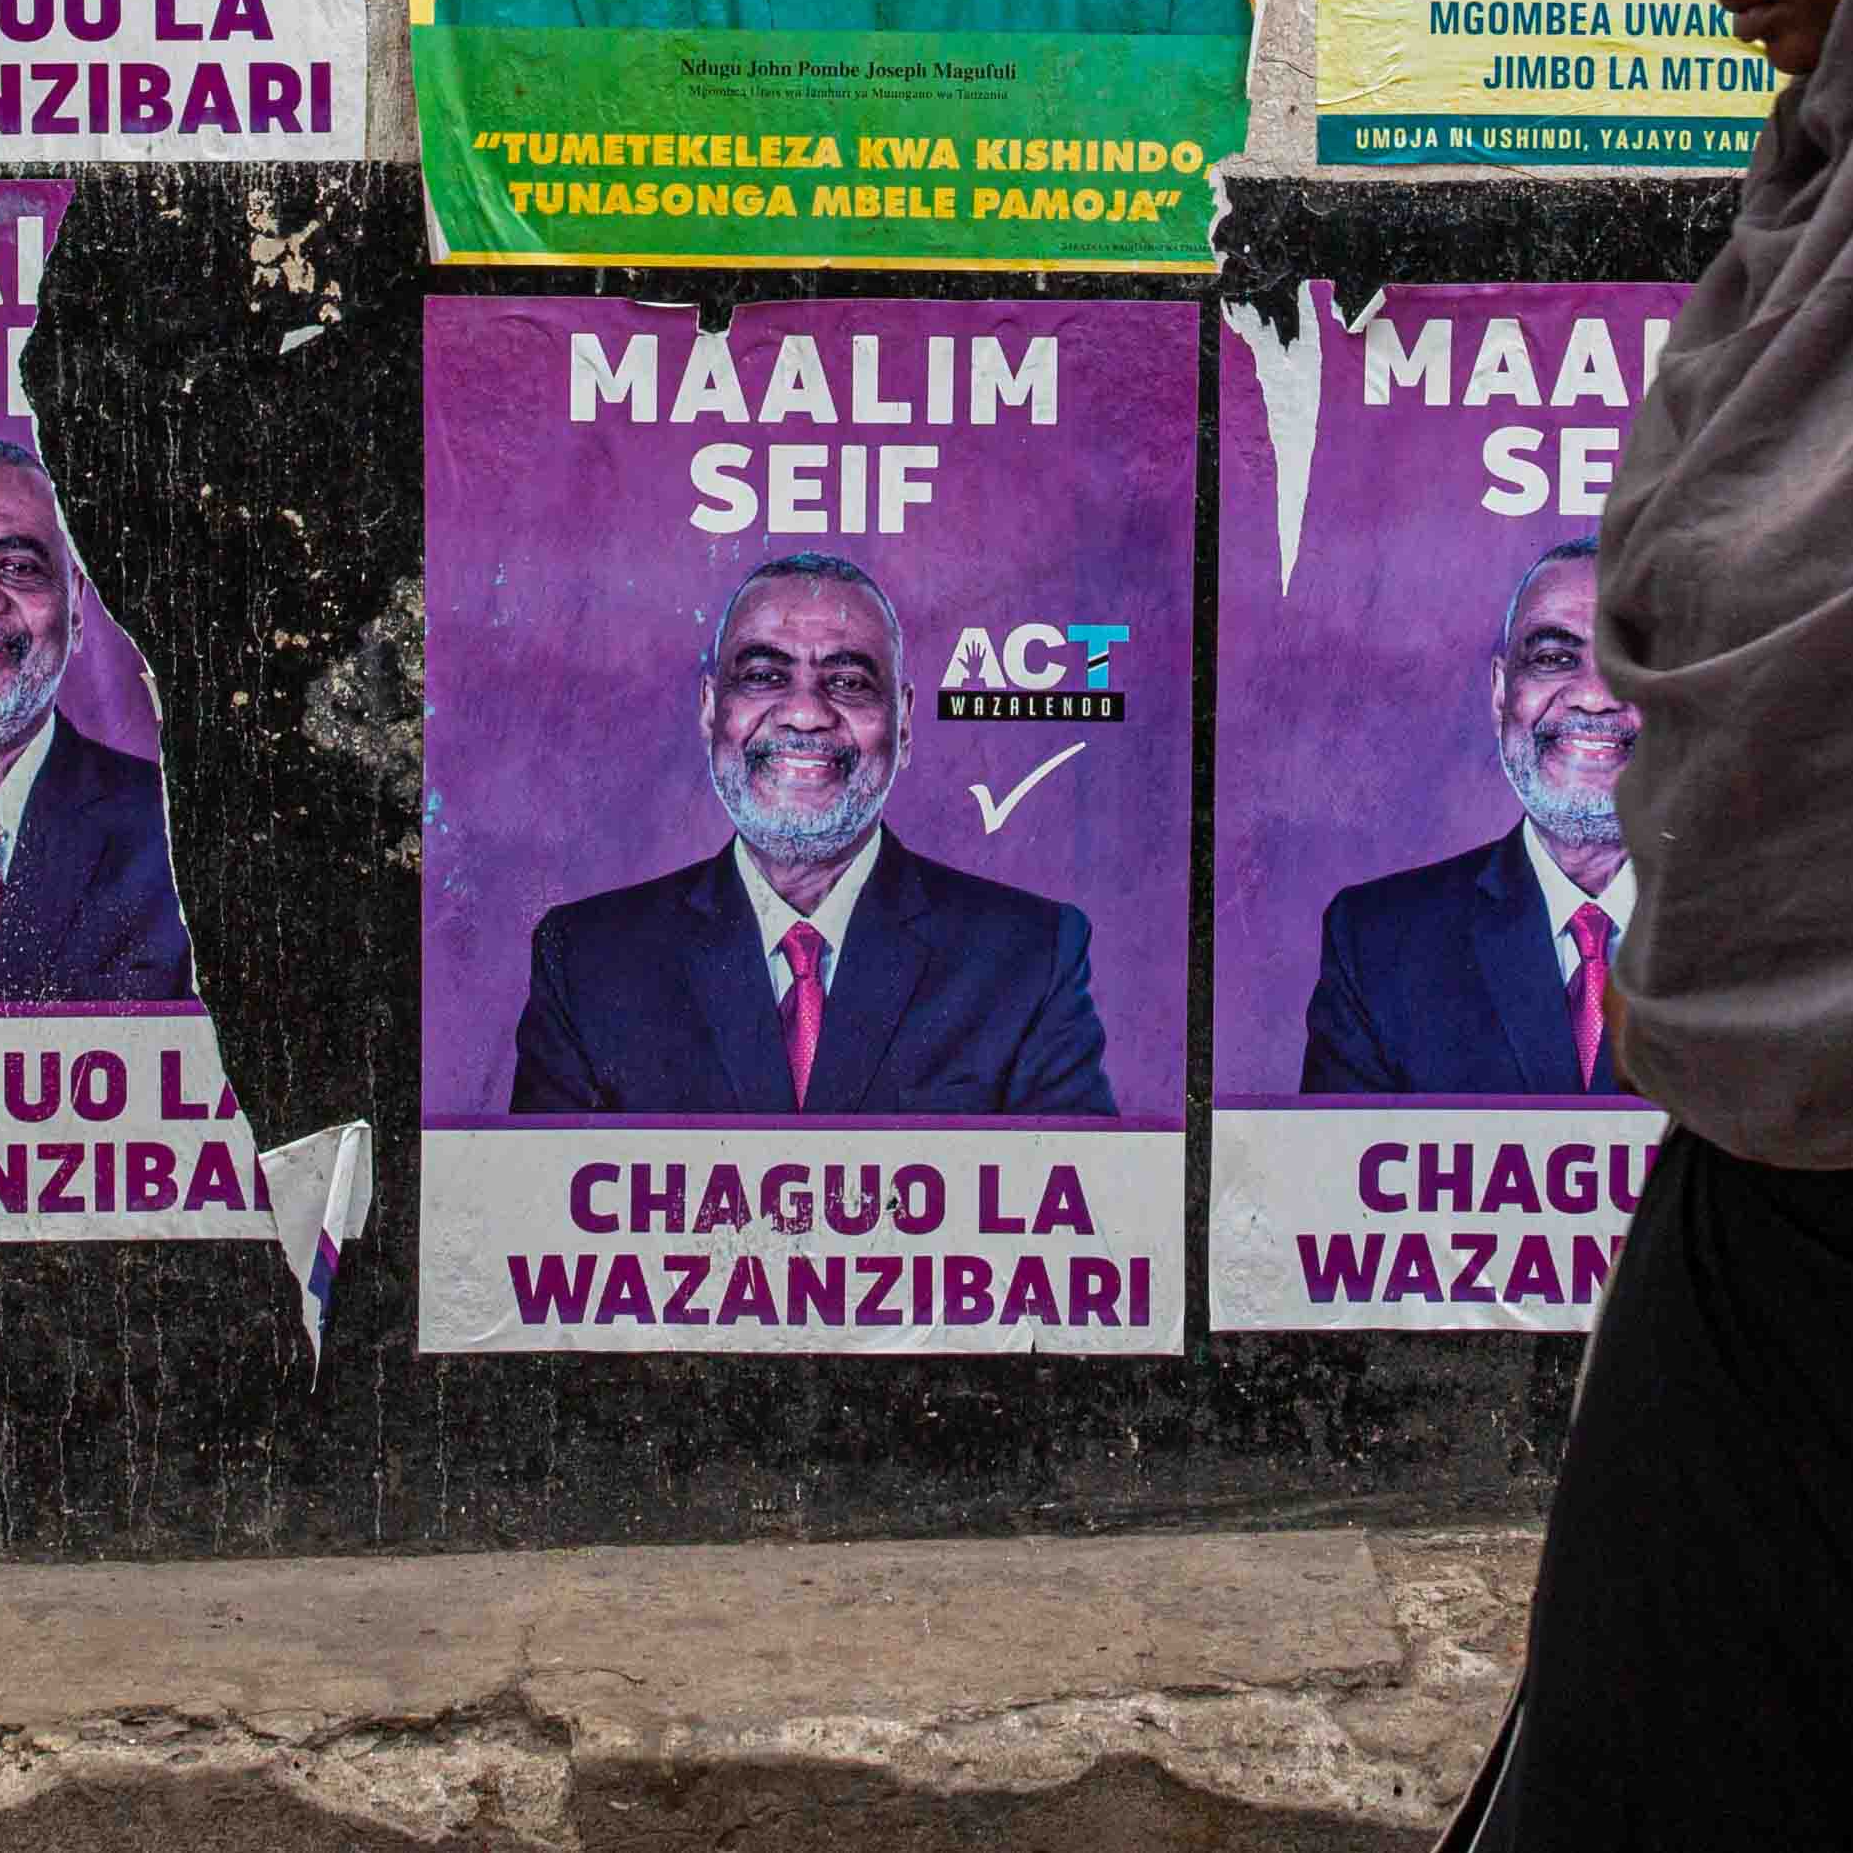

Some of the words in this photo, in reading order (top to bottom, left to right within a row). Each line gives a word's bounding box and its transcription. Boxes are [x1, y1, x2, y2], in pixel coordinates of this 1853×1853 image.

[1430, 2, 1611, 36] MGOMBEA
[680, 58, 742, 79] Ndugu
[746, 58, 792, 78] John
[798, 60, 860, 78] Pombe
[865, 61, 927, 81] Joseph
[932, 61, 1018, 83] Magufuli
[1484, 56, 1595, 91] JIMBO
[1609, 56, 1648, 91] LA
[1662, 56, 1776, 92] MTONI
[859, 136, 960, 171] KWA
[975, 138, 1214, 181] KISHINDO,
[1355, 127, 1439, 150] UMOJA
[1450, 128, 1474, 150] NI
[1484, 128, 1590, 153] USHINDI,
[1600, 128, 1693, 151] YAJAYO
[507, 181, 798, 220] TUNASONGA
[812, 185, 956, 221] MBELE
[569, 332, 1059, 425] MAALIM
[688, 443, 940, 535] SEIF
[939, 622, 1130, 692] ACT
[950, 695, 1113, 717] WAZALENDO
[569, 1161, 946, 1236] CHAGUO
[978, 1163, 1095, 1236] LA
[507, 1253, 1152, 1327] WAZANZIBARI
